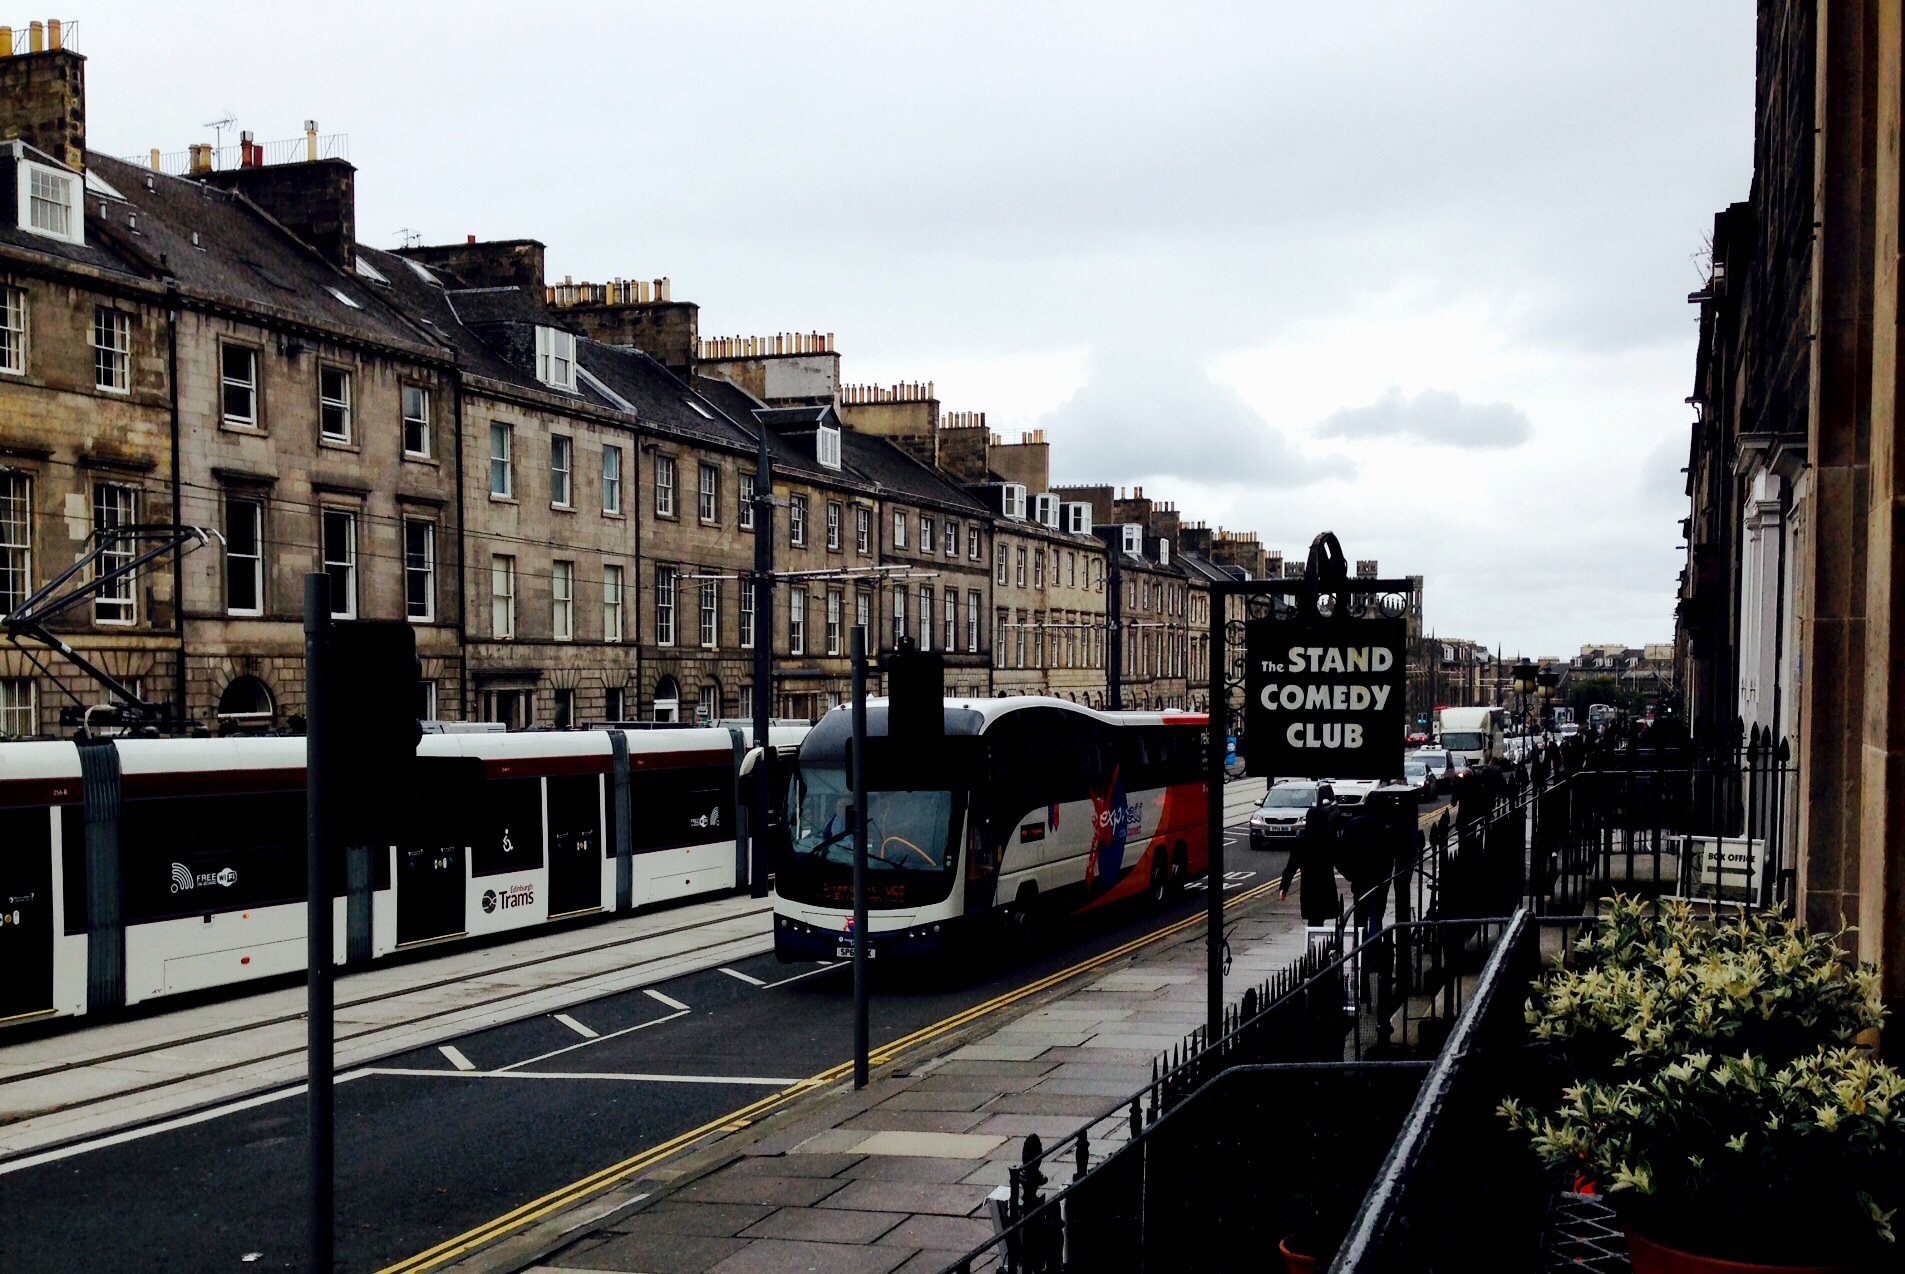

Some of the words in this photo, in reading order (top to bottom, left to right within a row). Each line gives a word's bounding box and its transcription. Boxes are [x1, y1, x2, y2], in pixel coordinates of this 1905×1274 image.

[1261, 660, 1285, 673] The
[1288, 646, 1394, 674] STAND
[1260, 683, 1392, 711] COMEDY
[1286, 722, 1365, 749] CLUB
[1708, 853, 1725, 861] BOX
[1727, 854, 1756, 862] OFFIE
[196, 872, 217, 882] FREE
[510, 883, 533, 894] Edinburgh
[499, 890, 534, 909] Trams
